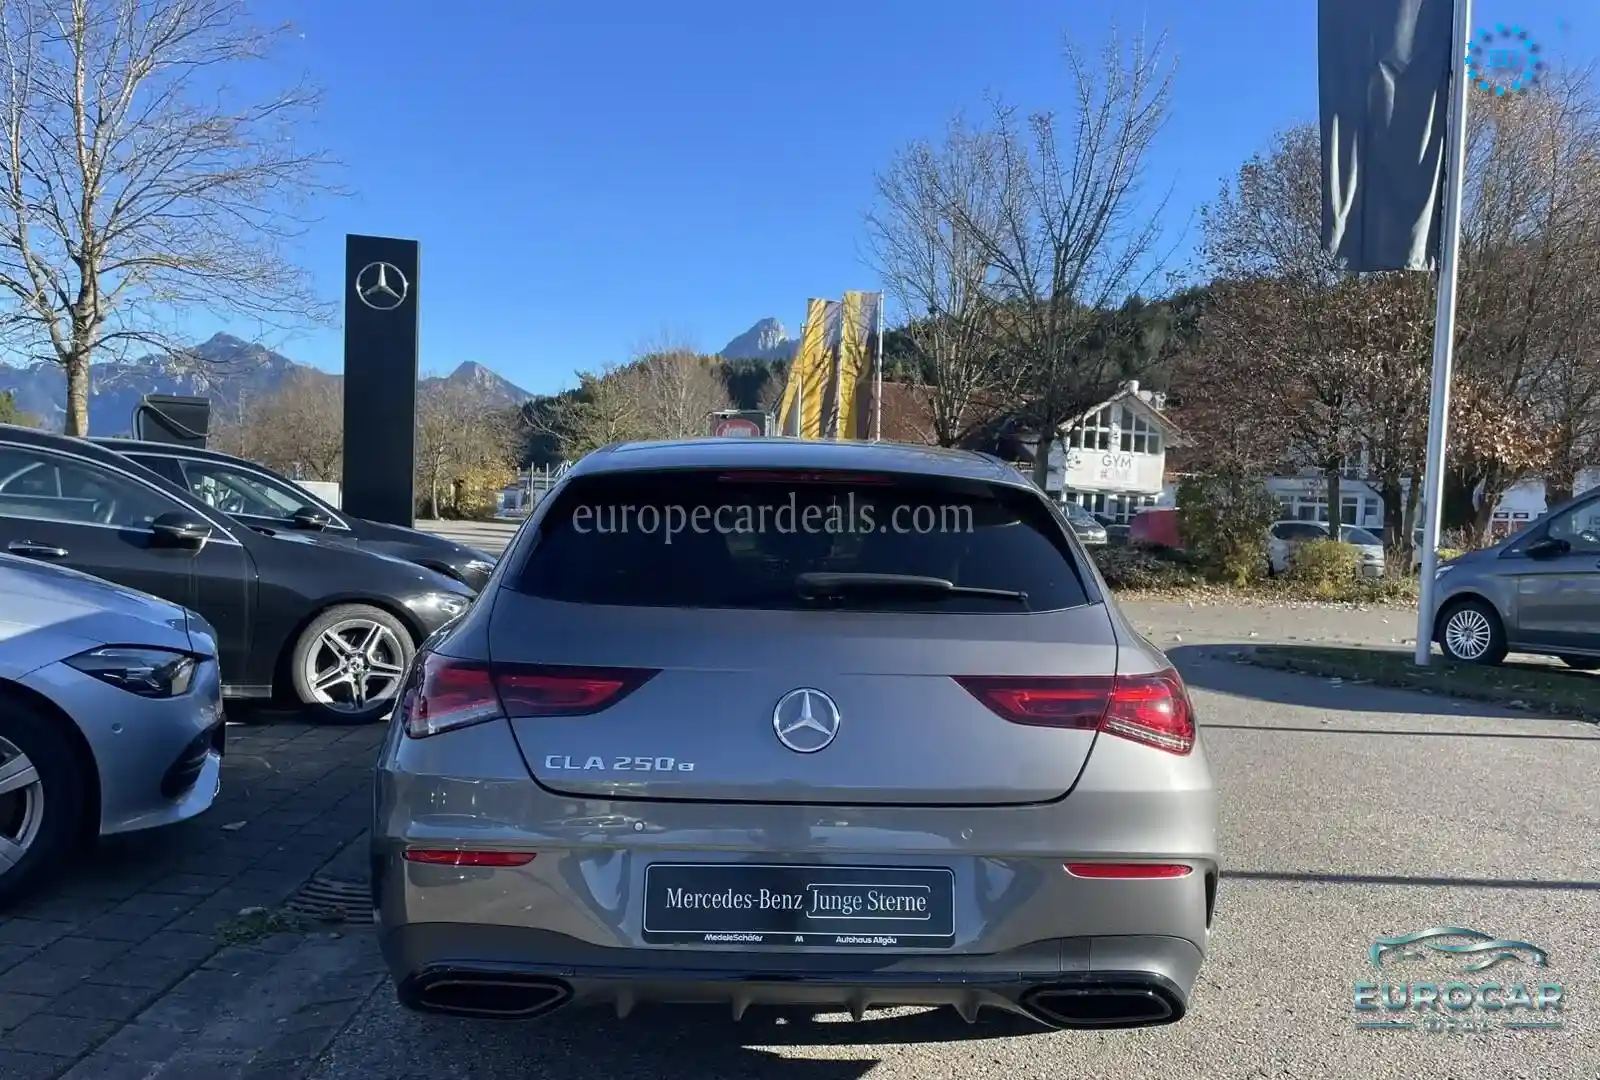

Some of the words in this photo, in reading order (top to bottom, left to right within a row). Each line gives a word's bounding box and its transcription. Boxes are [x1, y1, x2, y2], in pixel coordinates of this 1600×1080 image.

[1102, 454, 1131, 469] GYM
[545, 755, 605, 770] CLA
[666, 887, 803, 910] Mercedes-Benz
[811, 889, 863, 914] Junge
[867, 891, 927, 912] Sterne
[836, 935, 872, 944] Autohaus
